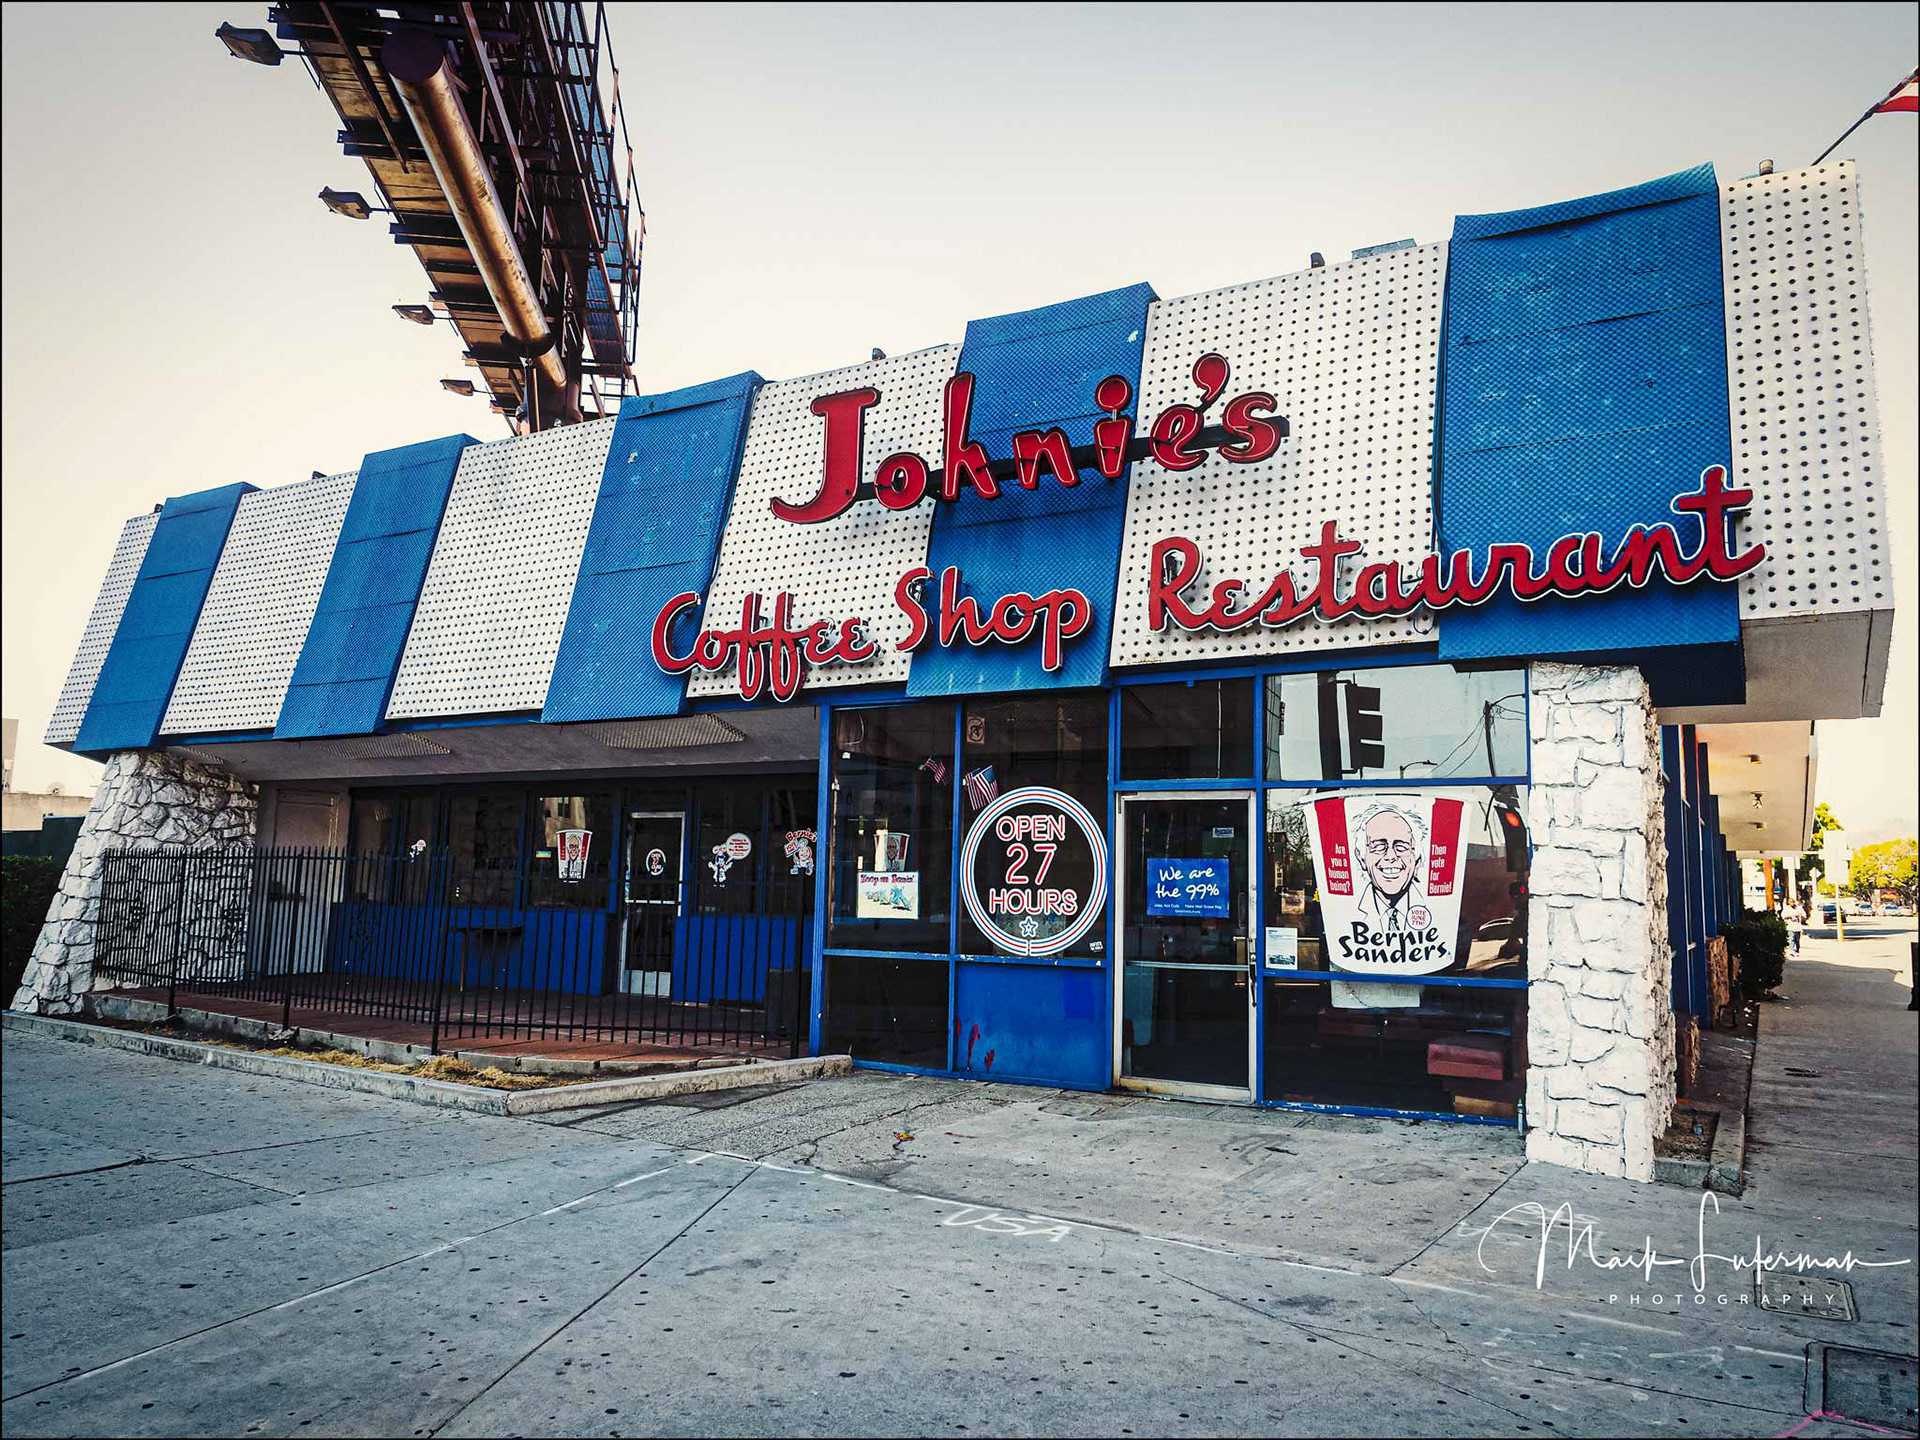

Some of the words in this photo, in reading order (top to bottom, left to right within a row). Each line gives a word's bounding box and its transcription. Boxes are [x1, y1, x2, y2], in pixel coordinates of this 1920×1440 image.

[769, 352, 1281, 525] Johnie's
[651, 590, 878, 703] Coffee
[894, 566, 1093, 673] Shop
[1149, 464, 1768, 633] Restaurant
[996, 814, 1065, 841] OPEN
[1334, 843, 1346, 855] Are
[1431, 844, 1447, 855] Then
[1007, 843, 1057, 885] 27
[1331, 857, 1343, 869] you
[1430, 858, 1445, 868] vote
[1159, 866, 1184, 882] We
[1188, 867, 1215, 879] are
[1328, 869, 1349, 880] human
[1430, 870, 1440, 880] for
[1155, 883, 1182, 898] the
[1185, 883, 1220, 901] 99%
[1329, 881, 1351, 893] being?
[1429, 881, 1452, 894] Bernie!
[989, 888, 1078, 915] HOURS
[1350, 921, 1439, 947] Bernie
[1338, 935, 1448, 964] Sanders
[942, 1208, 1073, 1243] USA
